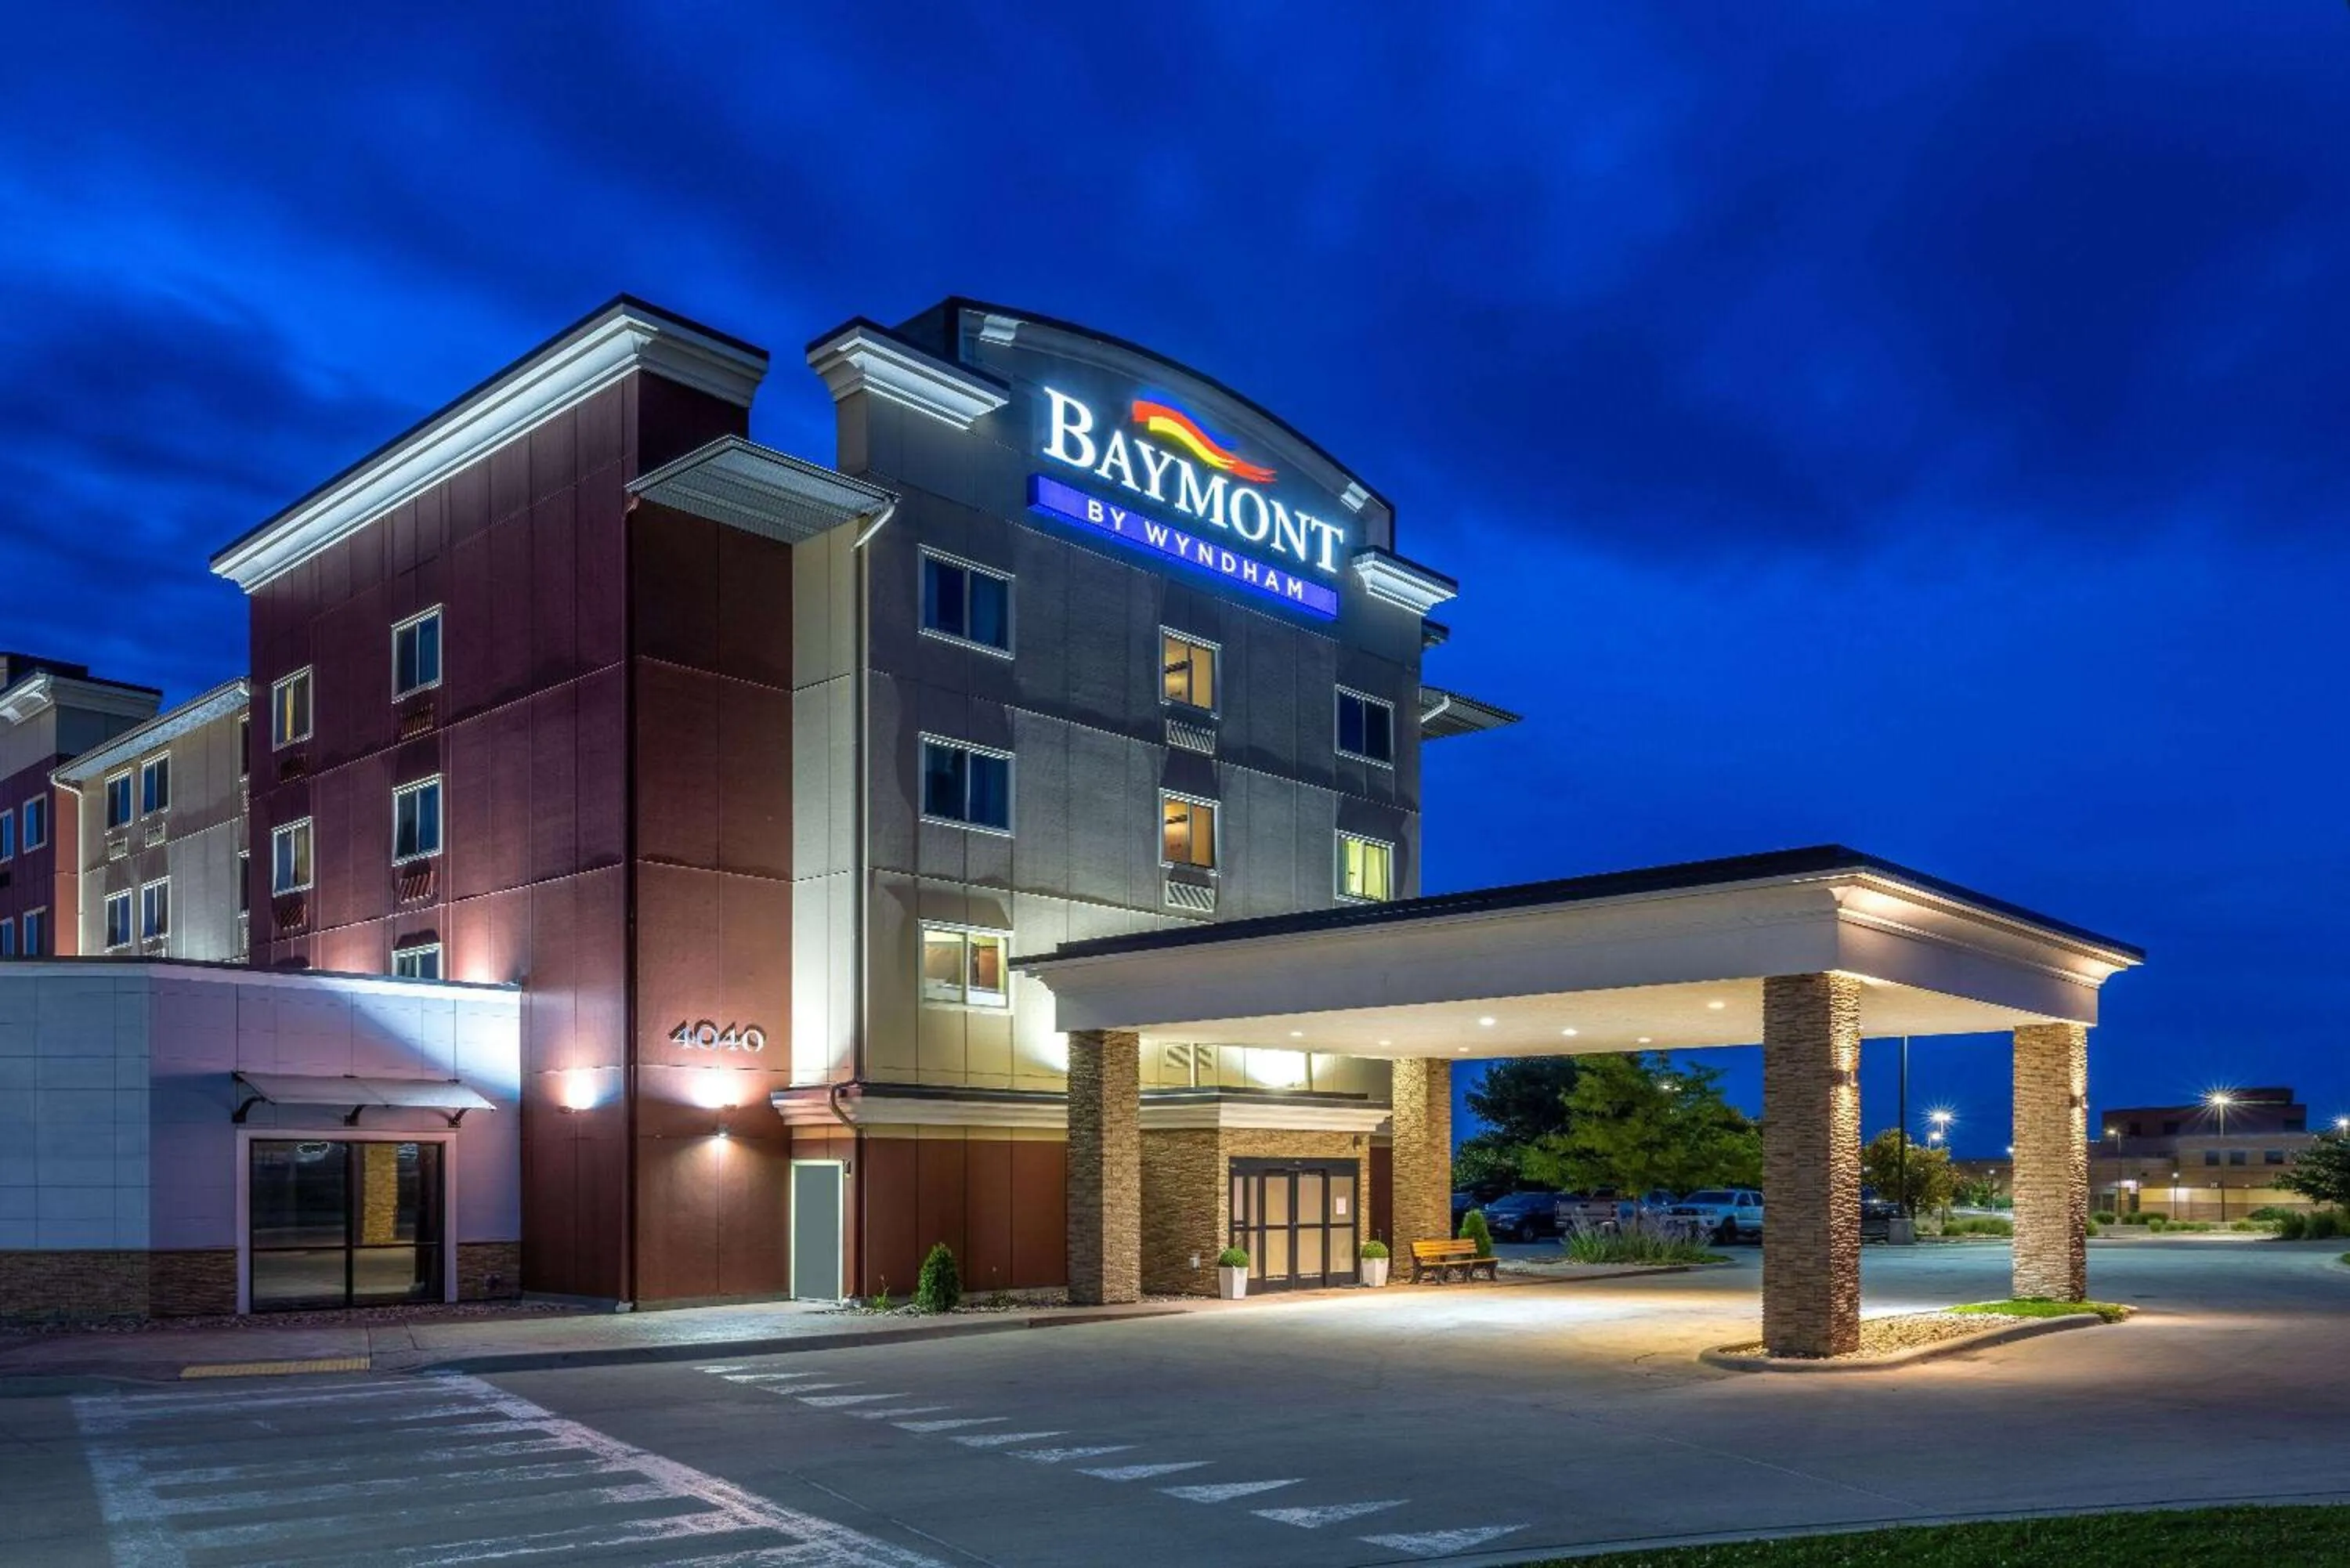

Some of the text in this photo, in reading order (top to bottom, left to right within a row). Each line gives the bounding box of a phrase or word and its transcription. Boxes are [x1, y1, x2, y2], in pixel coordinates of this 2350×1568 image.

[1043, 387, 1343, 573] BAYMONT
[1087, 499, 1304, 600] BY WYNDHAM
[669, 1021, 766, 1052] 4040
